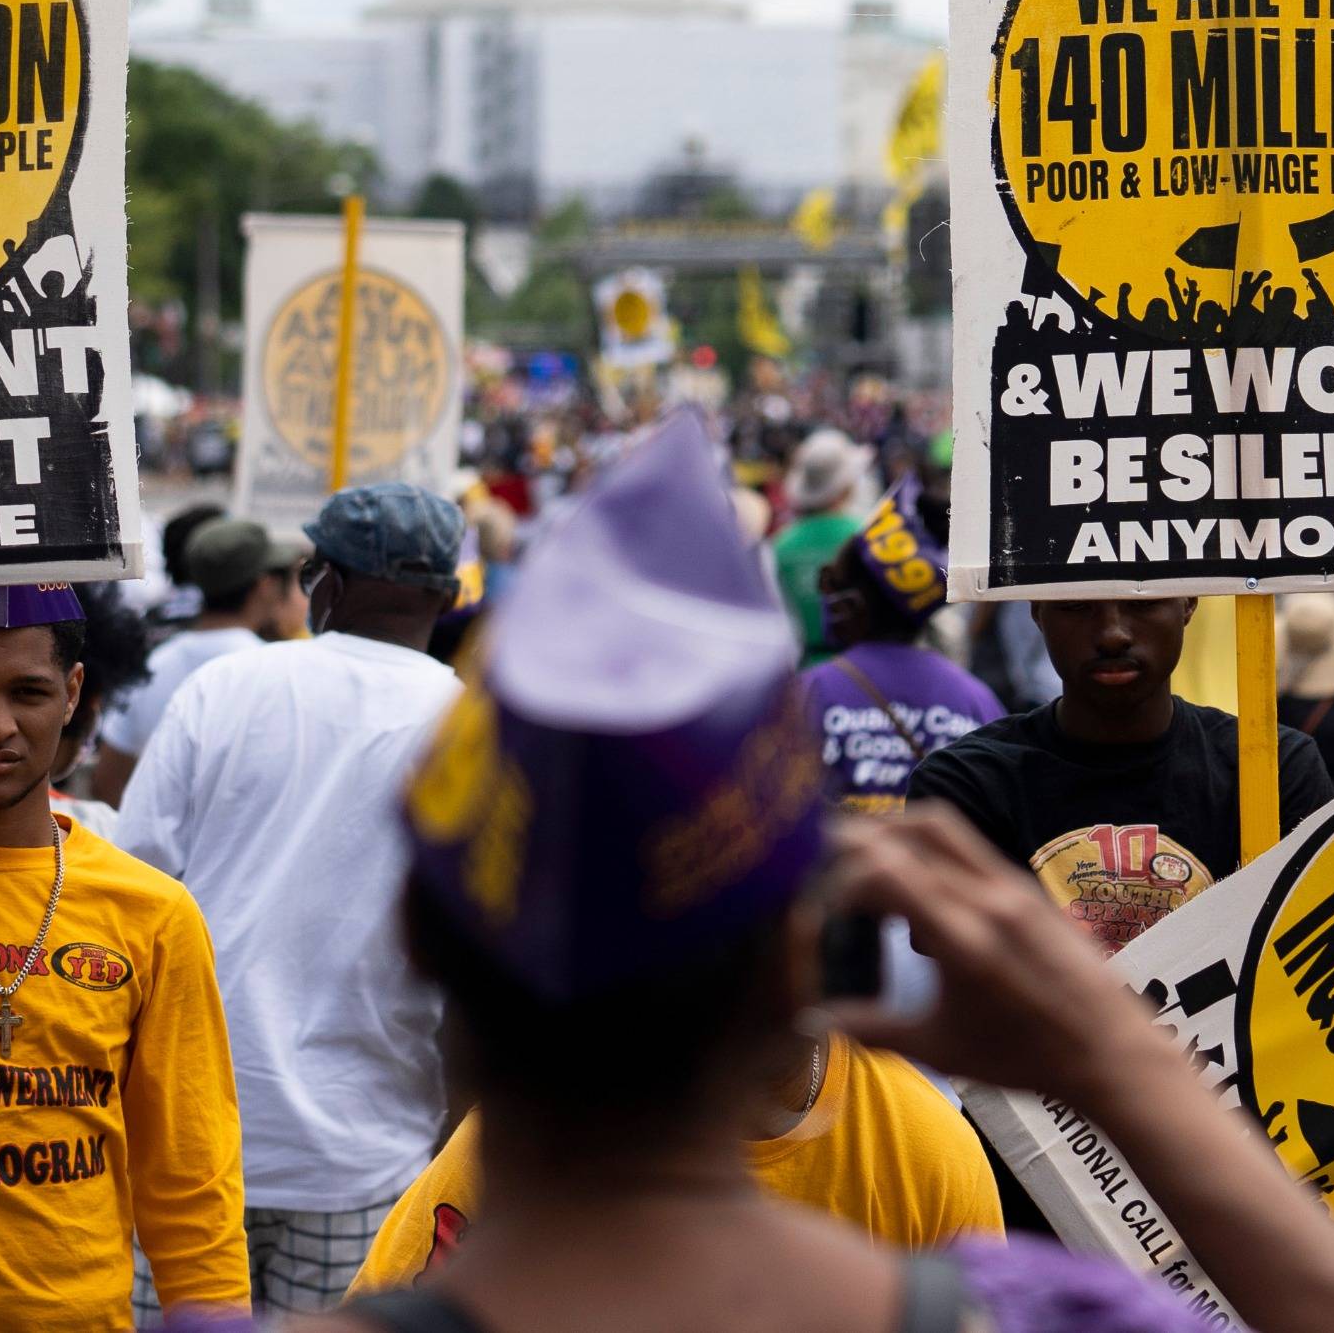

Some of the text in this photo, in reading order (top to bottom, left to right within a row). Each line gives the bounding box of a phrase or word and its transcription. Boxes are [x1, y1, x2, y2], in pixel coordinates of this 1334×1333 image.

[1010, 31, 1148, 157] 140
[1027, 161, 1106, 203] POOR
[1120, 164, 1141, 198] &
[1153, 153, 1319, 197] LOW-WAGE
[1050, 438, 1150, 507] BE
[1087, 824, 1158, 881] 10
[1077, 881, 1171, 908] YOUTH
[68, 957, 123, 984] YEP
[1121, 1200, 1174, 1265] CALL
[1161, 1260, 1196, 1296] for
